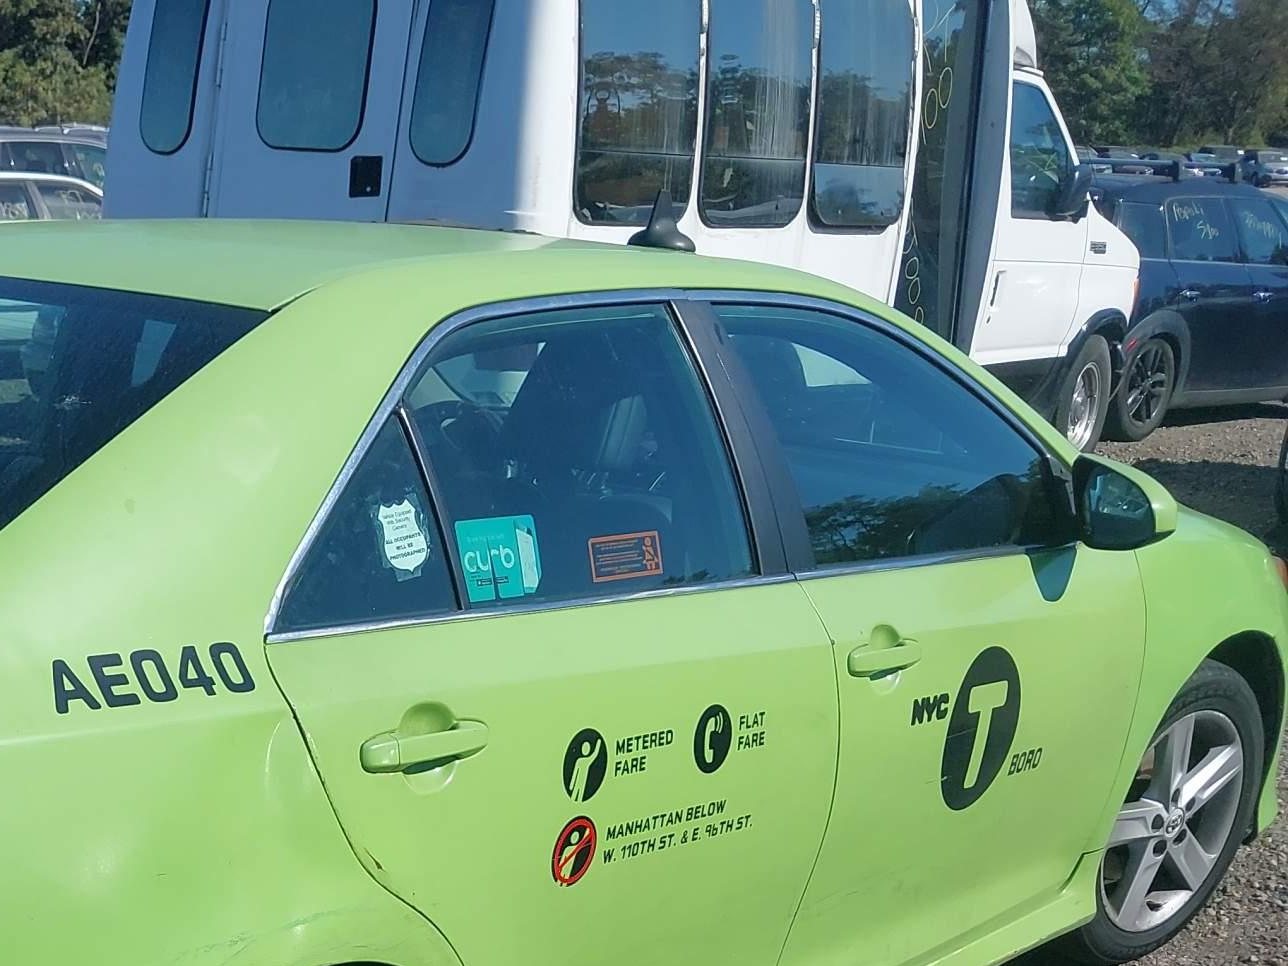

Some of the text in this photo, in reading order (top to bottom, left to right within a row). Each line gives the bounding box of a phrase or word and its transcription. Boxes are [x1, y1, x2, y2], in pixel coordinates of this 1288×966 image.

[464, 544, 515, 572] curb
[738, 711, 765, 731] FLAT
[911, 693, 950, 726] NYC
[616, 729, 674, 755] METERED
[737, 731, 765, 751] FARE
[614, 756, 647, 777] FARE
[1008, 747, 1043, 776] BORO
[606, 799, 727, 841] MANHATTAN BELOW
[603, 814, 753, 864] W. 110TH ST. & E. 96TH ST.
